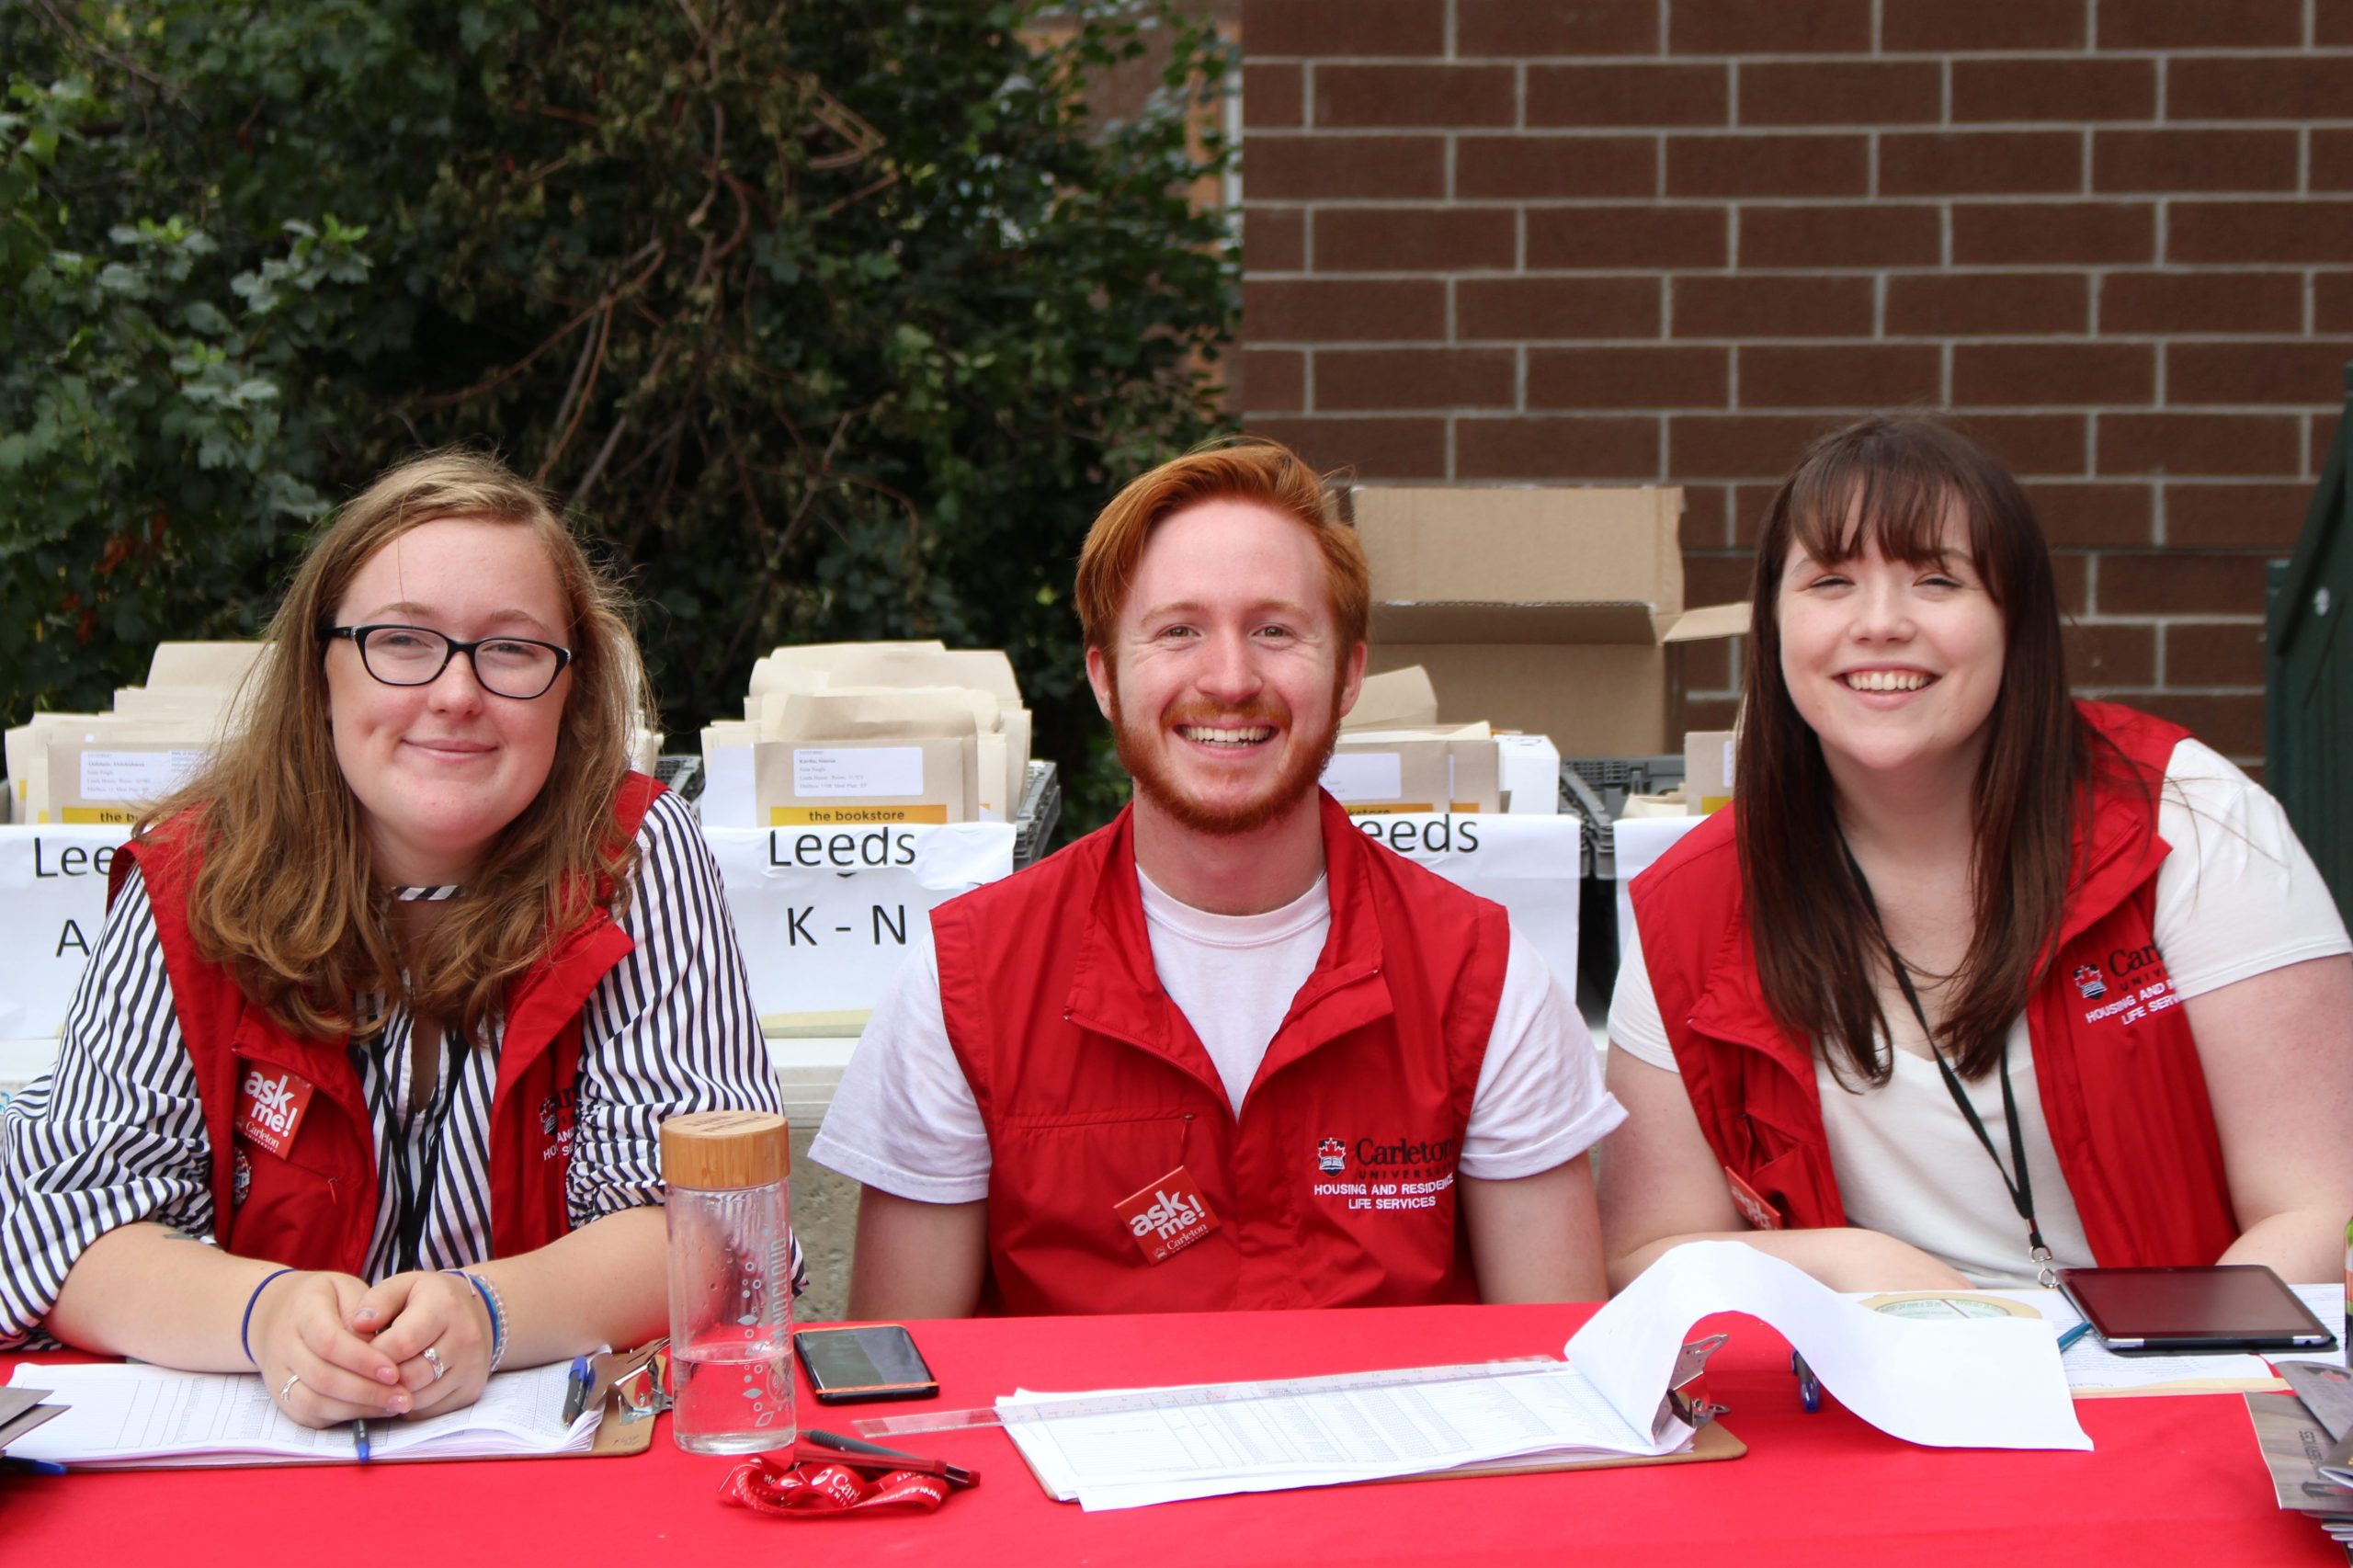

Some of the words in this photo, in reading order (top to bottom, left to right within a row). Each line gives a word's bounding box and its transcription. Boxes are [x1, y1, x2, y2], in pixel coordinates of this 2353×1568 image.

[100, 812, 121, 823] the
[809, 812, 831, 822] the
[835, 810, 905, 822] bookstore
[769, 826, 915, 867] Leeds
[56, 919, 90, 957] A
[788, 906, 817, 946] K
[872, 904, 906, 945] N
[2085, 994, 2137, 1024] HOUSING
[2139, 983, 2165, 1001] AND
[2120, 1006, 2147, 1025] LIFE
[244, 1071, 294, 1117] ask
[245, 1120, 279, 1149] Carleton
[250, 1101, 298, 1138] me!
[1355, 1137, 1454, 1165] Carleton
[1314, 1184, 1367, 1195] HOUSING
[1371, 1184, 1397, 1195] AND
[1348, 1199, 1371, 1210] LIFE
[1376, 1196, 1436, 1209] SERVICES
[1130, 1190, 1189, 1236] ask
[1157, 1194, 1206, 1240] me!
[1166, 1223, 1207, 1250] Carleton
[770, 1238, 788, 1297] CLOUD
